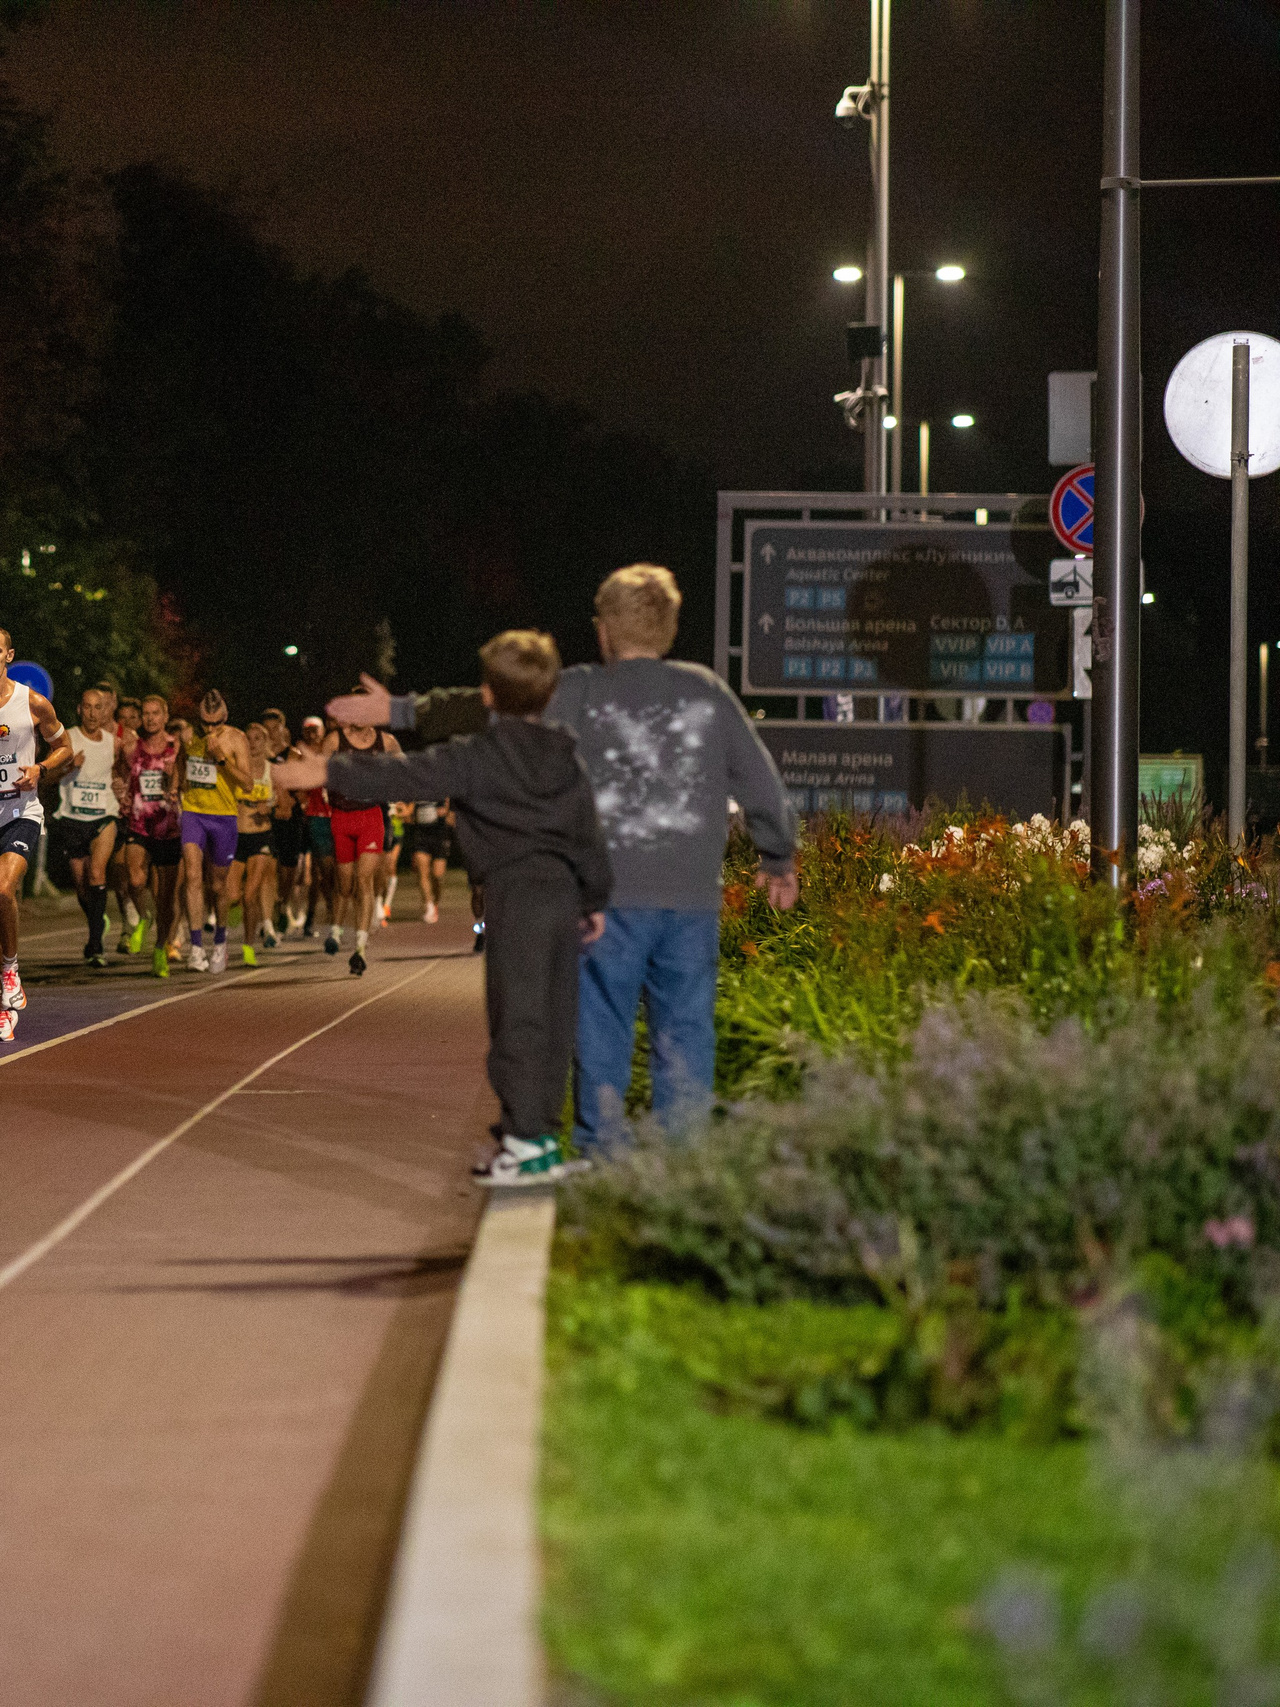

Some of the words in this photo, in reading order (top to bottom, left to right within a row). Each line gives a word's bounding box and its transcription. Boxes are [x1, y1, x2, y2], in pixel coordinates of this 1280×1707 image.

[785, 616, 858, 632] Большая
[862, 621, 916, 636] арена
[930, 615, 990, 632] Сектор
[986, 639, 1016, 653] VIP
[985, 663, 1015, 678] VIP
[781, 750, 837, 766] Малая
[841, 754, 892, 770] арена
[191, 765, 210, 777] 265
[81, 791, 99, 802] 201
